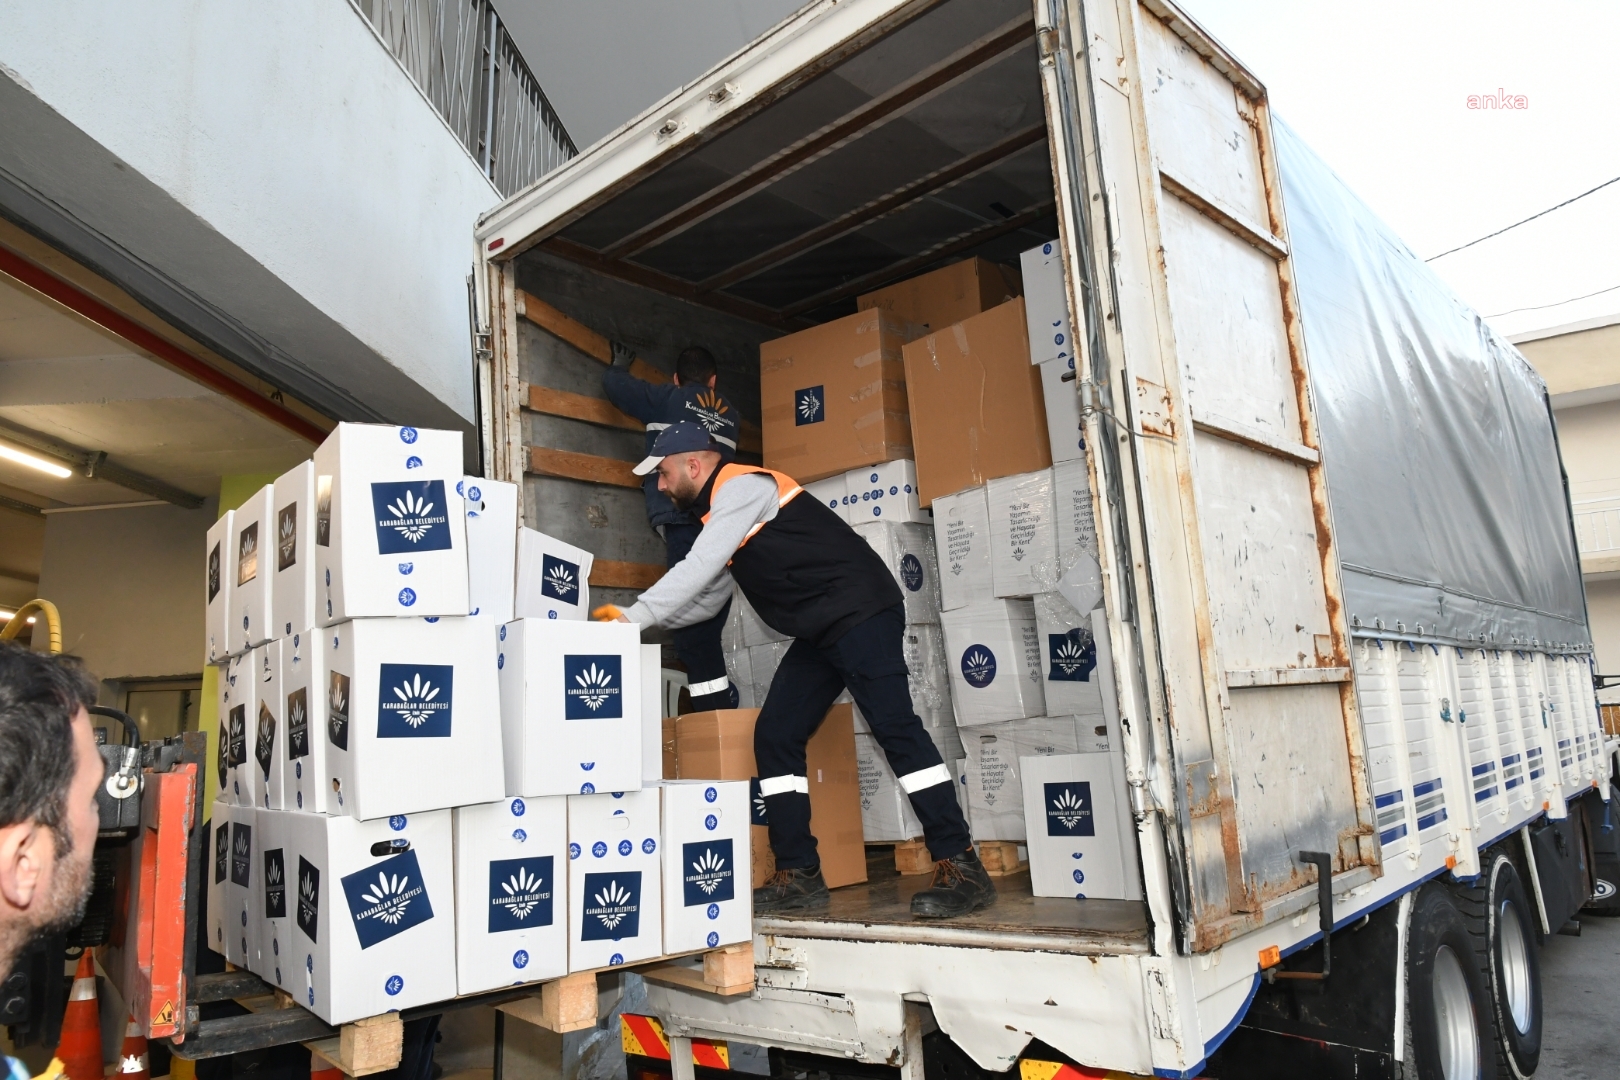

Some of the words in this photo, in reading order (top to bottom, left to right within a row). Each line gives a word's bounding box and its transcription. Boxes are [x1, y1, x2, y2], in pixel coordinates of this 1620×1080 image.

[380, 517, 414, 527] KARABAĞLAR
[415, 516, 446, 526] BELEDİYESİ
[568, 687, 595, 695] KARABAĞLAR
[596, 686, 620, 694] BELEDİYESİ
[382, 700, 418, 710] KARABAĞLAR
[418, 701, 450, 709] BELEDİYESİ
[356, 900, 392, 921] KARABAĞLAR
[392, 885, 423, 905] BELEDİYESİ
[492, 894, 523, 905] KARABAĞLAR
[524, 891, 551, 902] BELEDİYESİ
[586, 906, 613, 915] KARABAĞLAR
[614, 904, 638, 913] BELEDİYESİ
